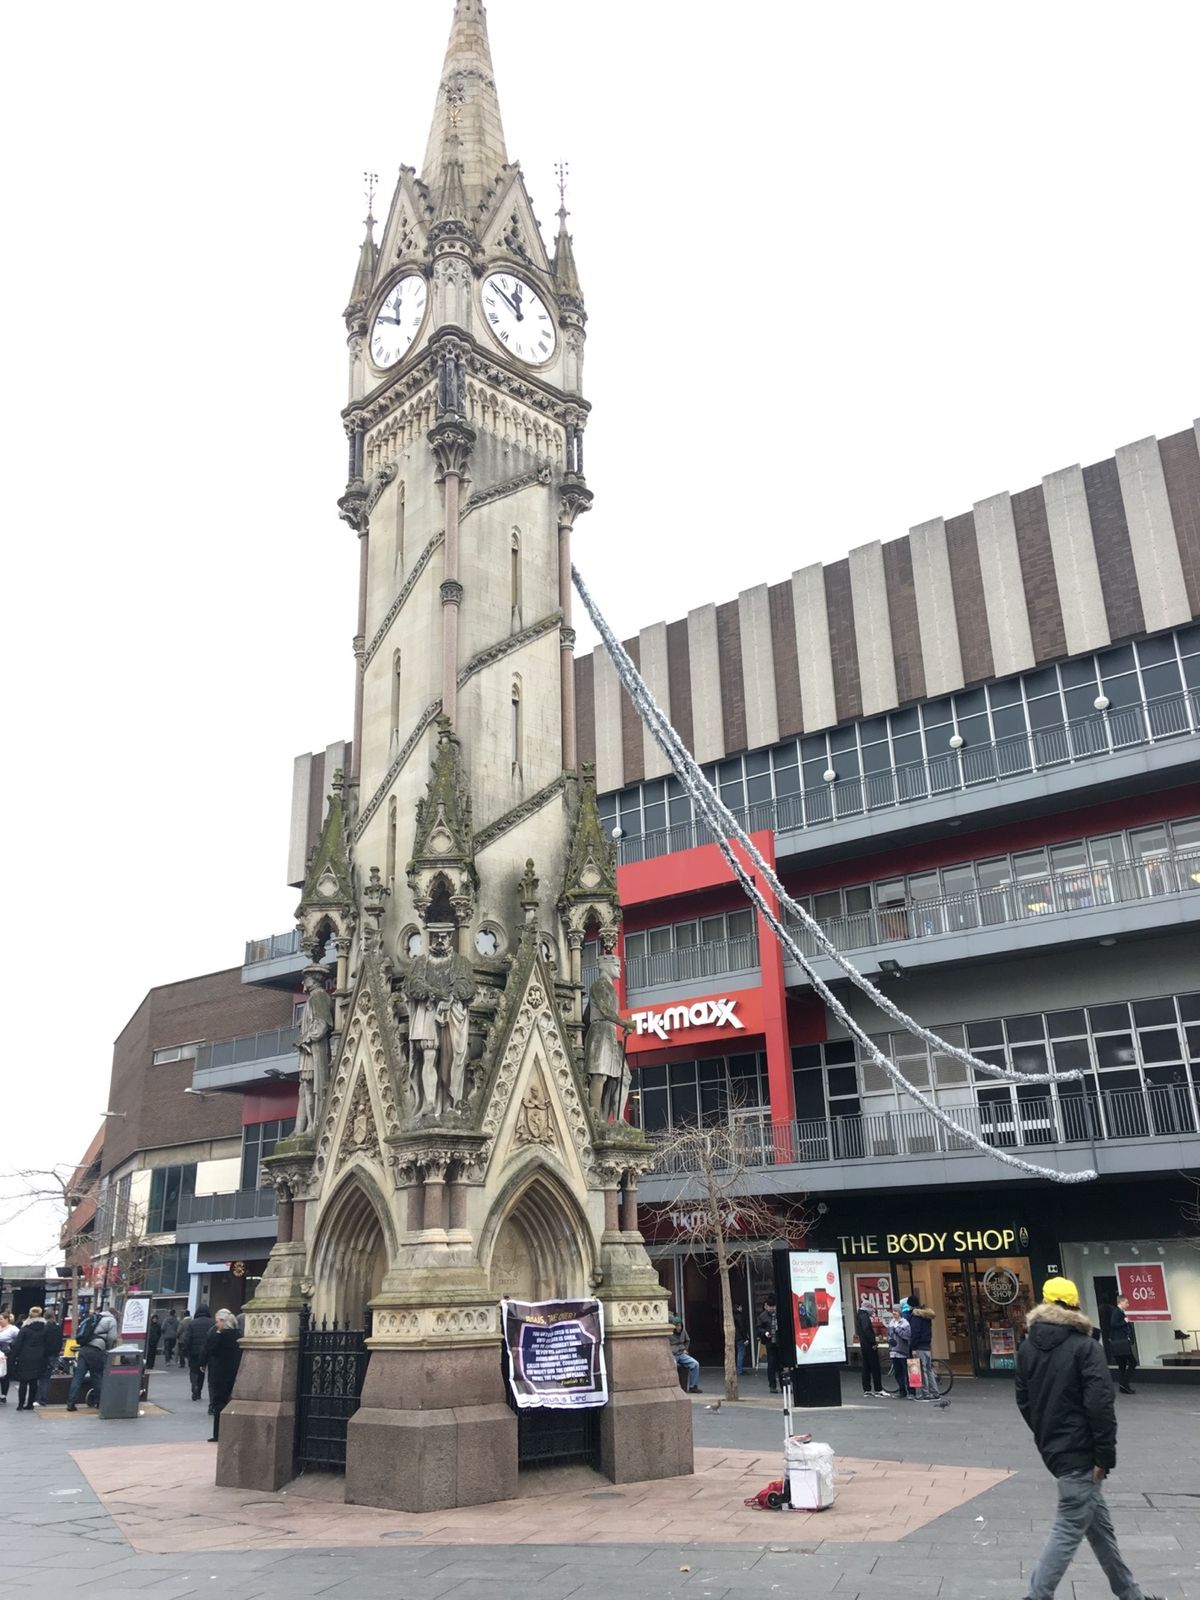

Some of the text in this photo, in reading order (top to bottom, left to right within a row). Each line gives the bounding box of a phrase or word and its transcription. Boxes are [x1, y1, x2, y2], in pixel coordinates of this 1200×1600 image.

[837, 1229, 1015, 1256] THE BODY SHOP
[1129, 1274, 1153, 1283] SALE
[990, 1283, 1013, 1291] BODY
[992, 1290, 1012, 1298] SHOP
